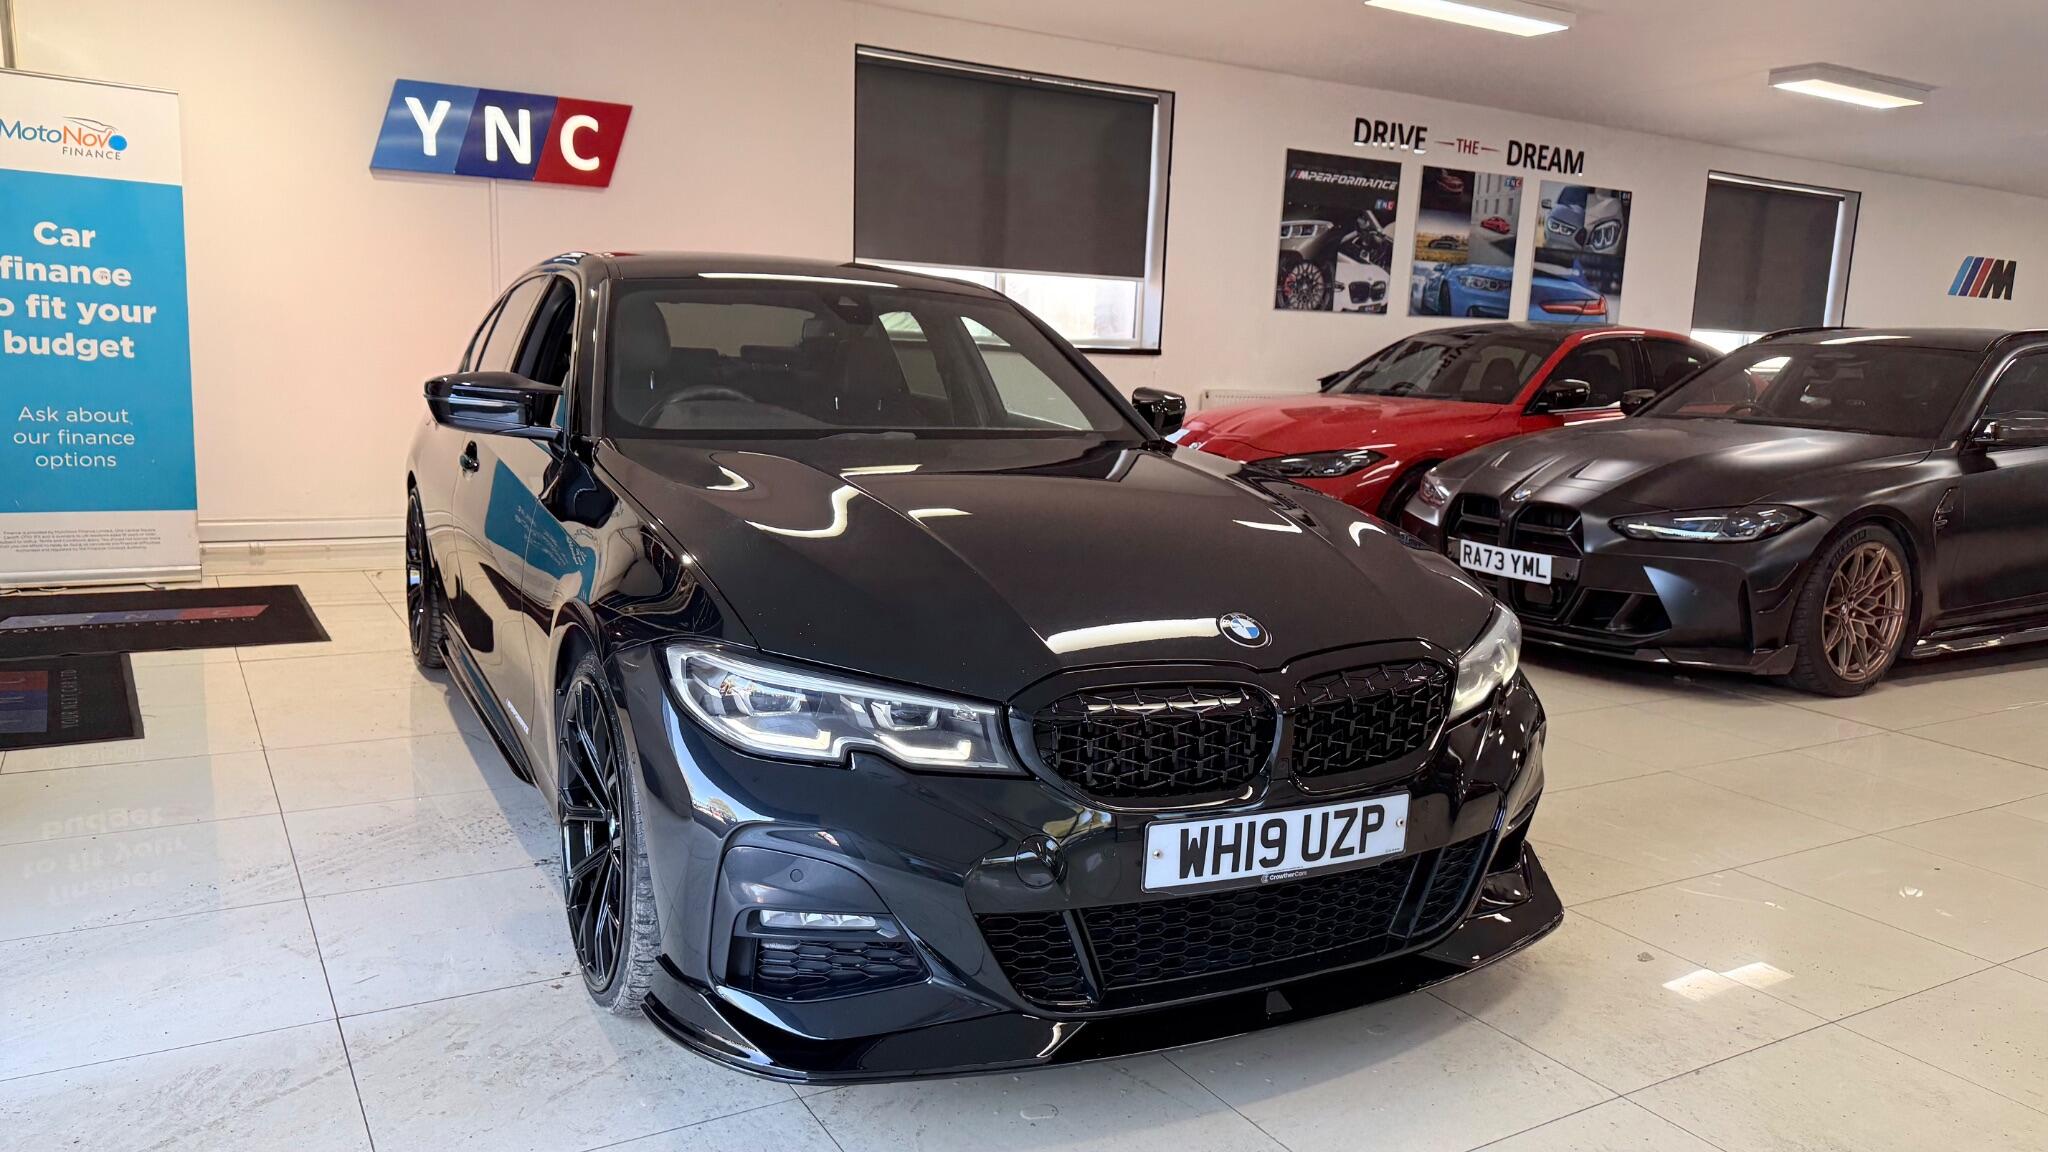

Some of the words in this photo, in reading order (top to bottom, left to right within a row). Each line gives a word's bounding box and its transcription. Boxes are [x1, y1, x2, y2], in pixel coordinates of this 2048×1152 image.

[405, 96, 600, 171] YNC
[1353, 117, 1428, 154] DRIVE
[1456, 138, 1479, 155] THE
[1506, 139, 1585, 176] DREAM
[62, 146, 121, 160] FINANCE
[33, 221, 96, 248] Car
[0, 256, 132, 287] finance
[0, 297, 15, 317] o
[25, 293, 67, 319] fit
[77, 302, 157, 325] your
[4, 329, 135, 361] budget
[18, 405, 59, 422] Ask
[66, 406, 128, 423] about
[13, 430, 50, 445] our
[58, 429, 135, 446] finance
[35, 451, 117, 470] options
[1463, 544, 1504, 571] RA73
[1511, 554, 1547, 579] YML
[1179, 818, 1287, 880] WH19
[1301, 804, 1385, 862] UZP
